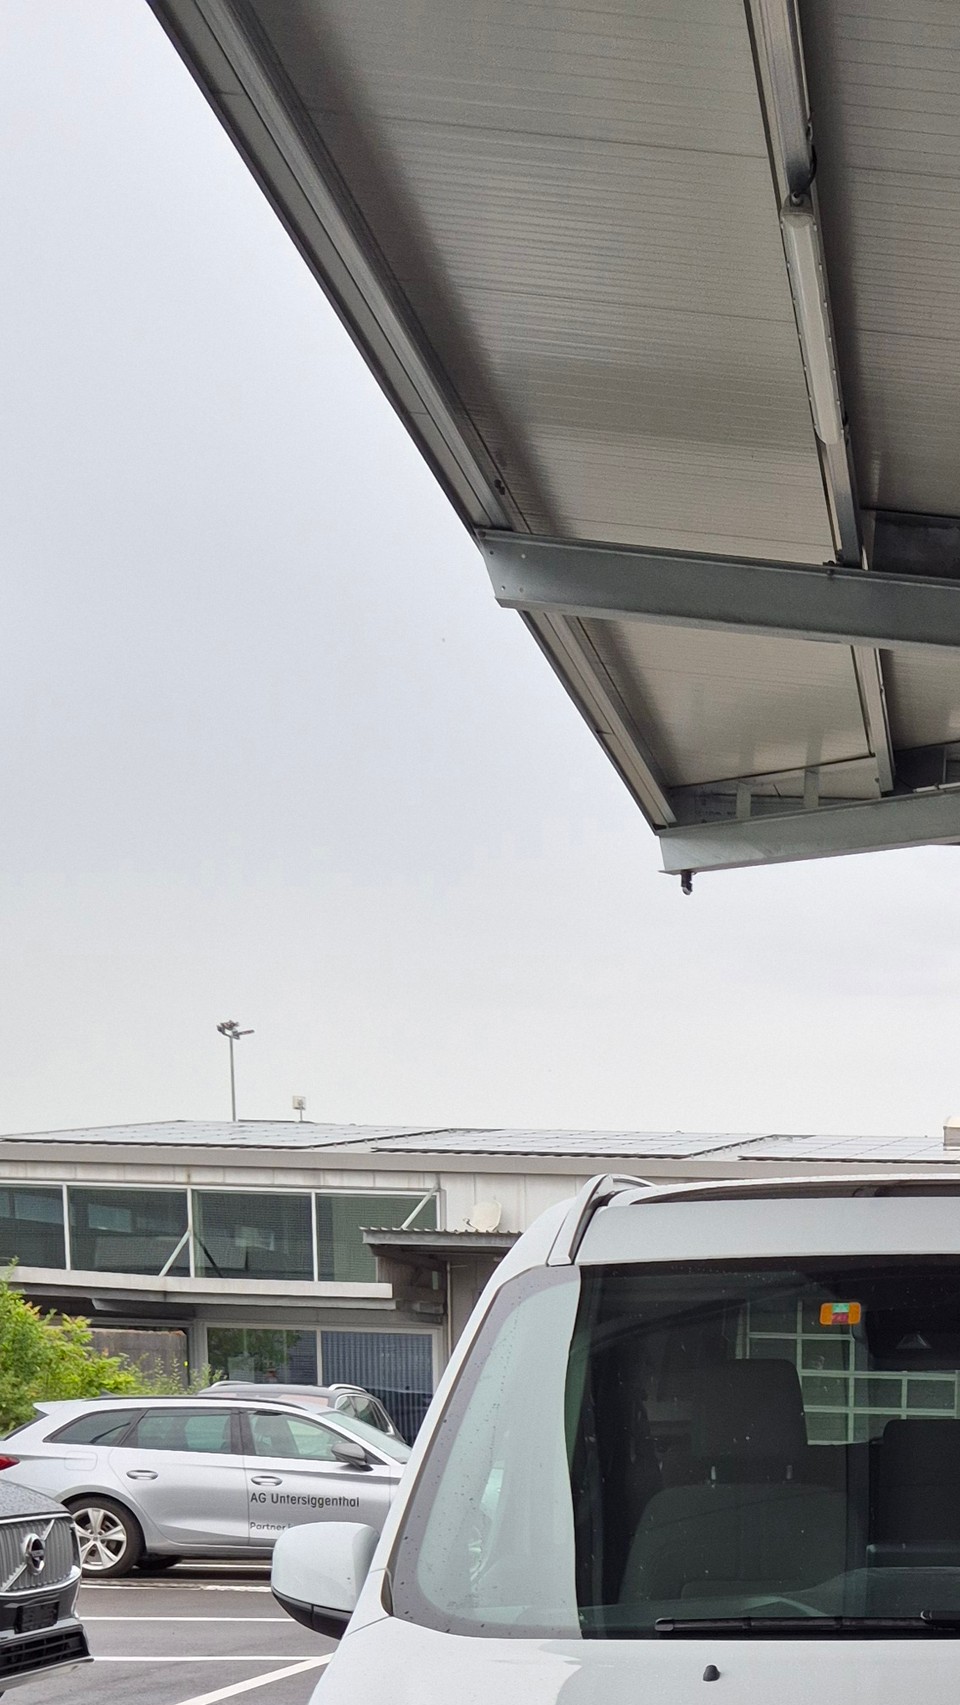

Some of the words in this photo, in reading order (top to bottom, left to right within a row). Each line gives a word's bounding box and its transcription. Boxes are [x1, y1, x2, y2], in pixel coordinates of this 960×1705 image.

[250, 1492, 267, 1503] AG
[271, 1493, 360, 1508] Untersiggenthal
[250, 1521, 286, 1531] Partner
